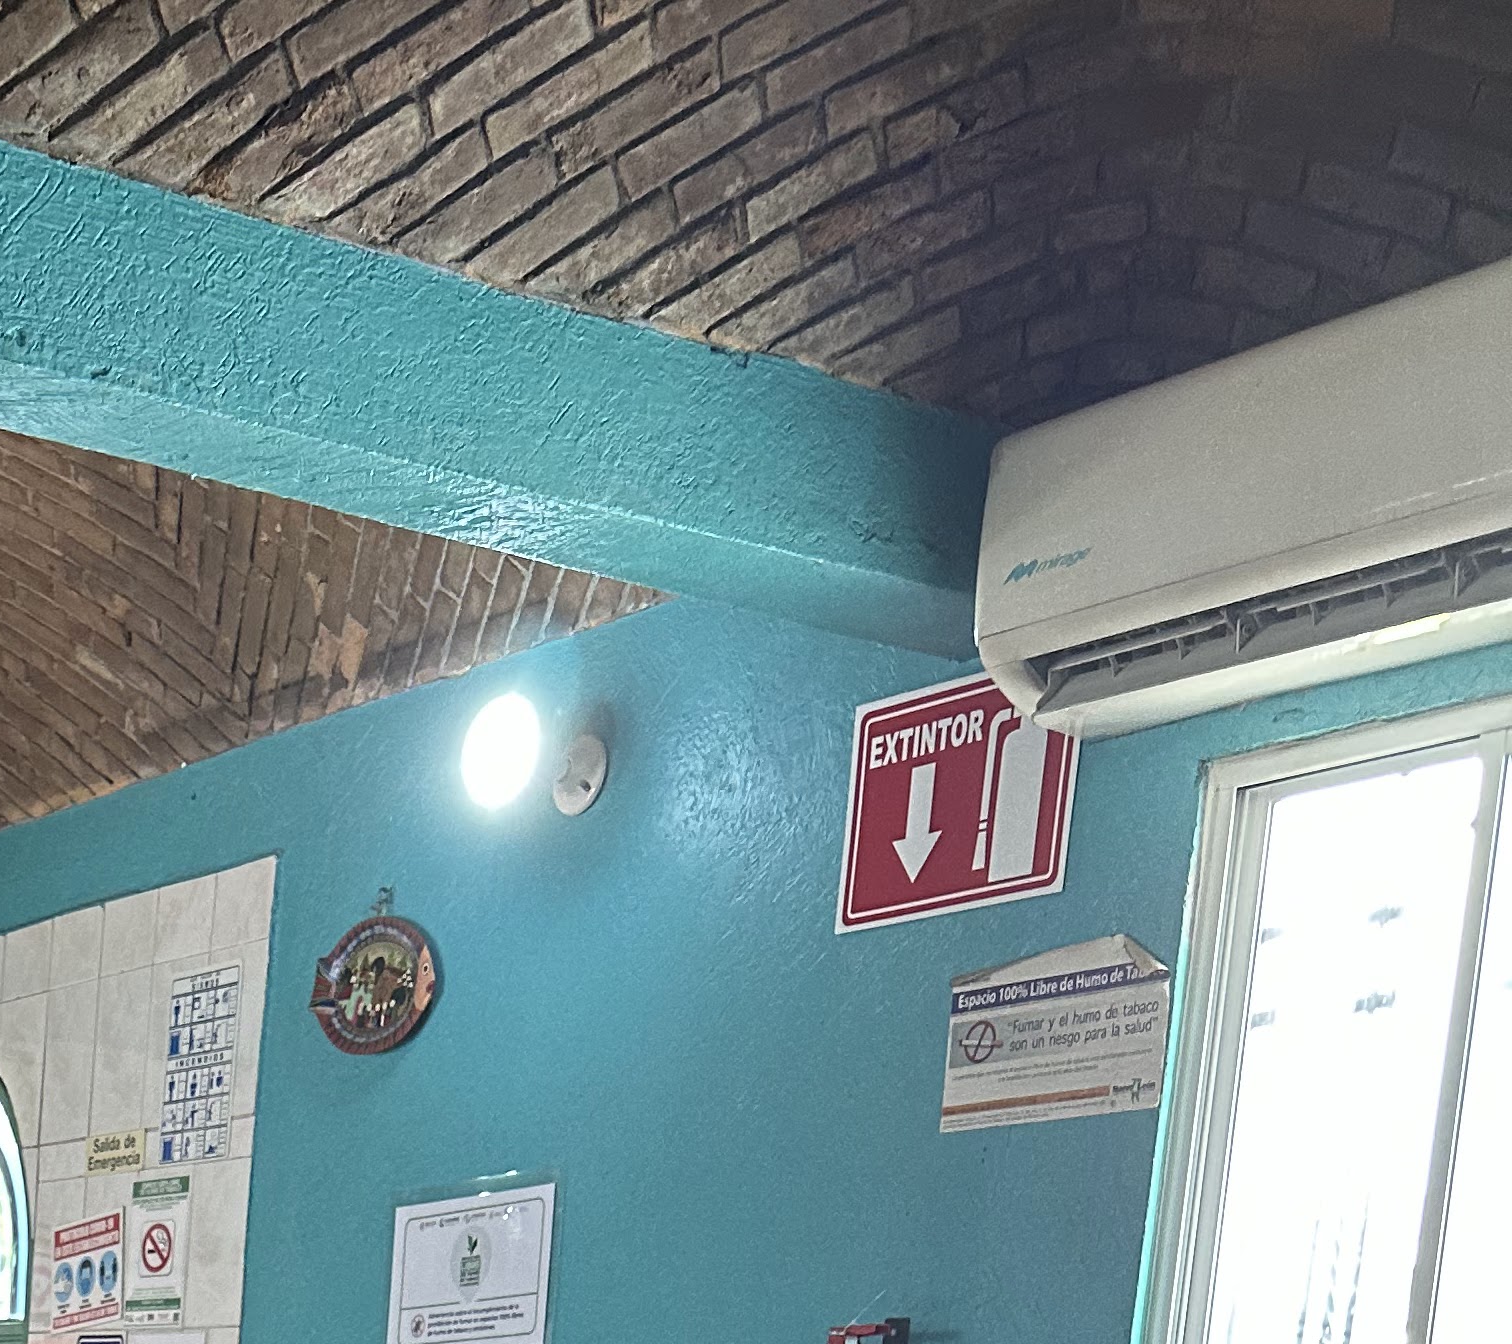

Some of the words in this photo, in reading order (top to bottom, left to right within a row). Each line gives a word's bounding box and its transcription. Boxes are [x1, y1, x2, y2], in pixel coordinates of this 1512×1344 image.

[869, 708, 985, 770] EXTINTOR
[958, 991, 996, 1011] Espacio
[999, 985, 1028, 1001] 100%
[1030, 982, 1058, 997] Libre
[1059, 977, 1073, 991] de
[1076, 973, 1108, 989] Humo
[1110, 967, 1124, 982] de
[1048, 1019, 1056, 1032] y
[1059, 1012, 1069, 1027] el
[1072, 1010, 1101, 1025] humo
[1105, 1005, 1119, 1020] de
[1123, 1000, 1160, 1018] tabaco
[1009, 1038, 1028, 1052] son
[1031, 1035, 1045, 1049] un
[1084, 1027, 1107, 1044] para
[1111, 1022, 1120, 1038] la
